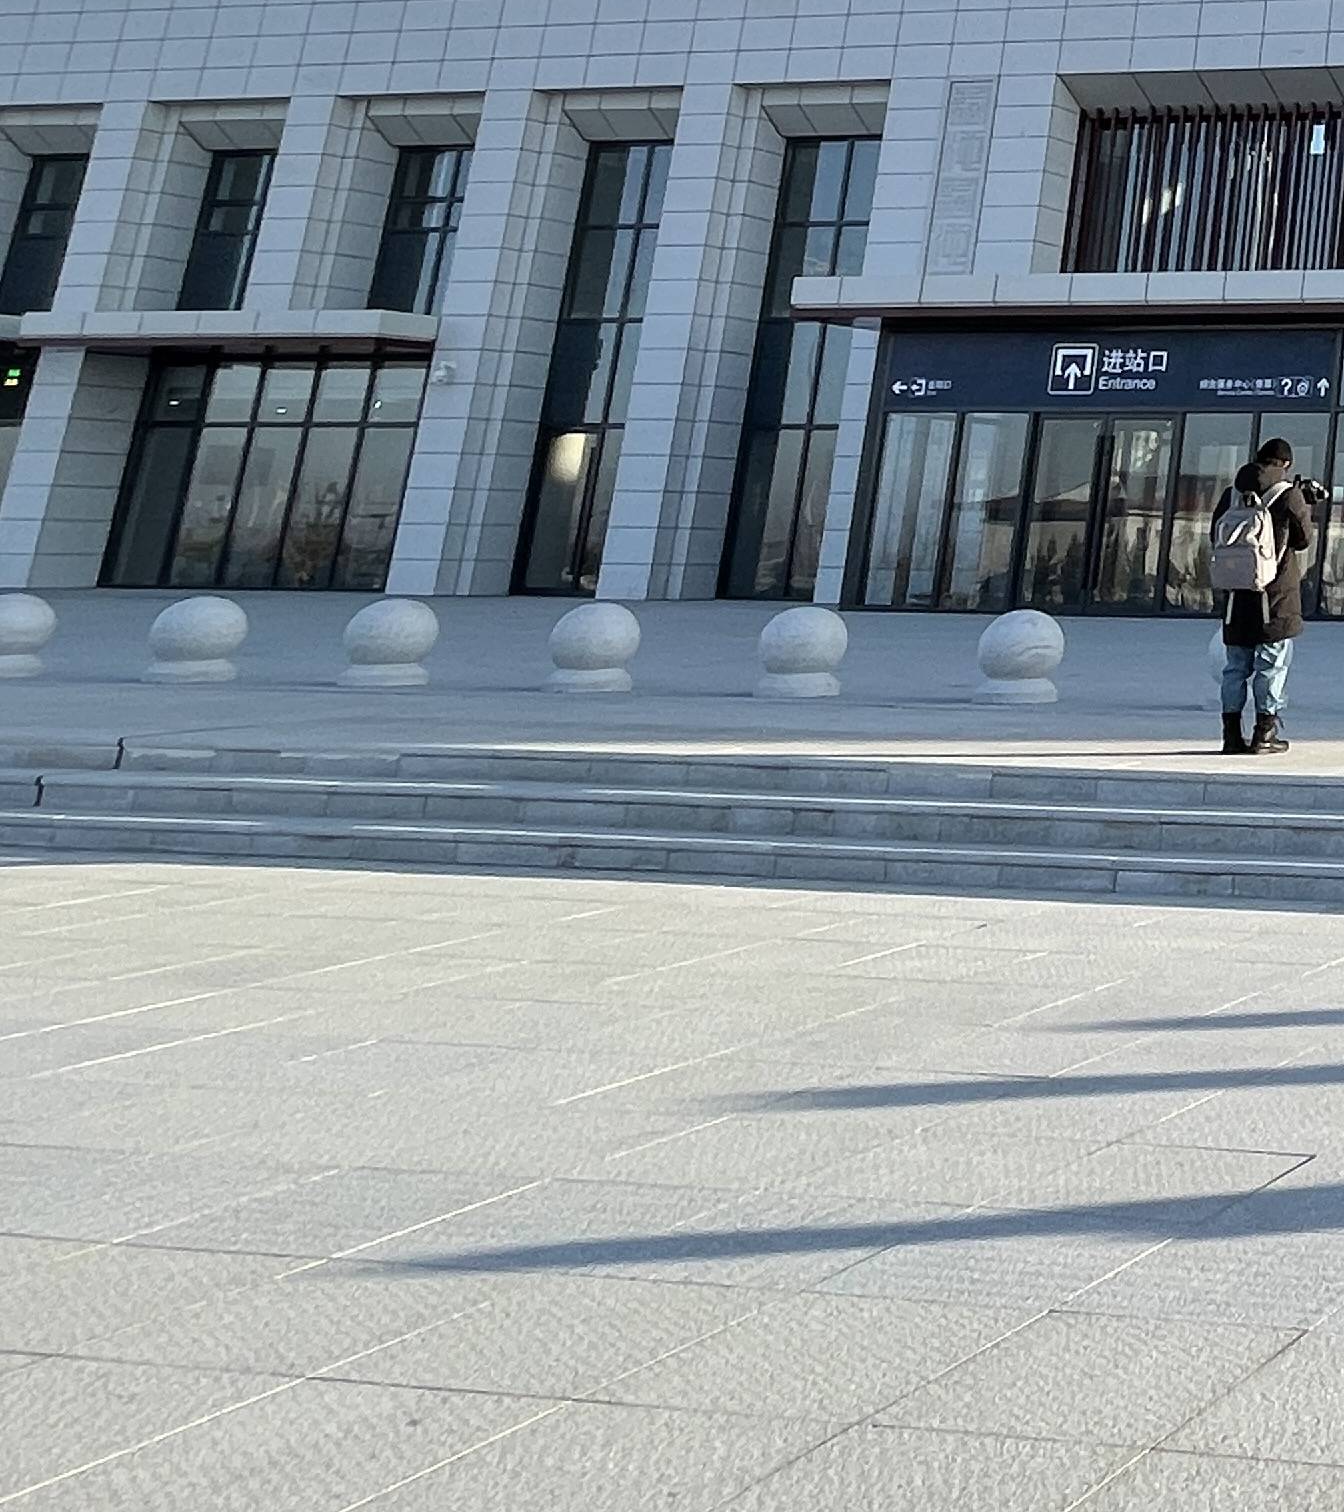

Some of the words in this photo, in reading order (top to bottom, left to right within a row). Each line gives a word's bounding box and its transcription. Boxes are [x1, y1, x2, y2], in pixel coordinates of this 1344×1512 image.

[1101, 349, 1168, 373] 进站口
[1099, 377, 1156, 389] Entrance
